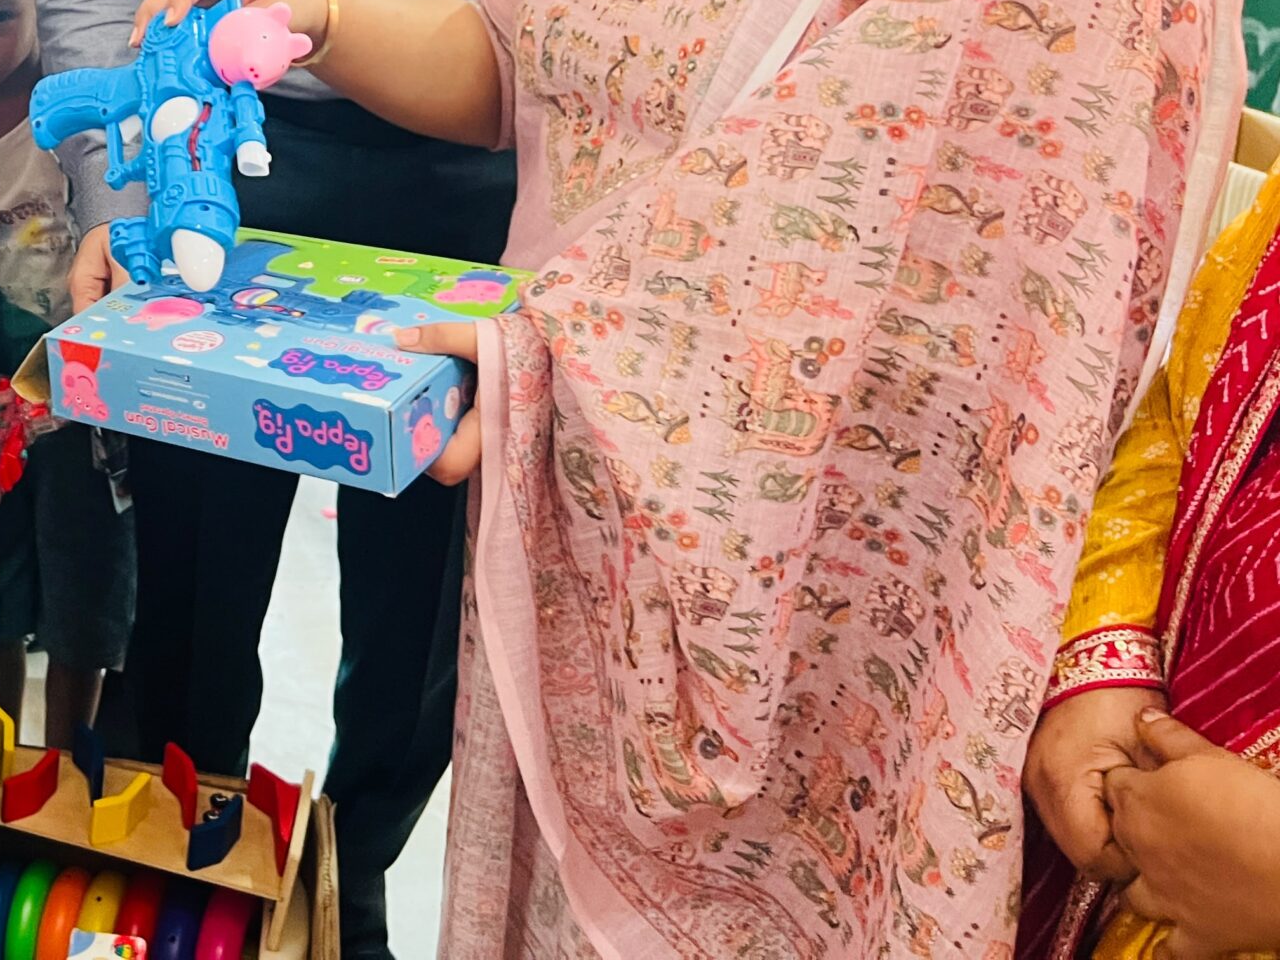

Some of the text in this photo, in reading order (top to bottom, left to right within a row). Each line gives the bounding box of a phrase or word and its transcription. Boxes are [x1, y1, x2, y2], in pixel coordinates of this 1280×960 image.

[281, 350, 392, 391] Peppa Pig
[123, 410, 230, 450] Musical Gun
[254, 404, 371, 473] Peppa Pig
